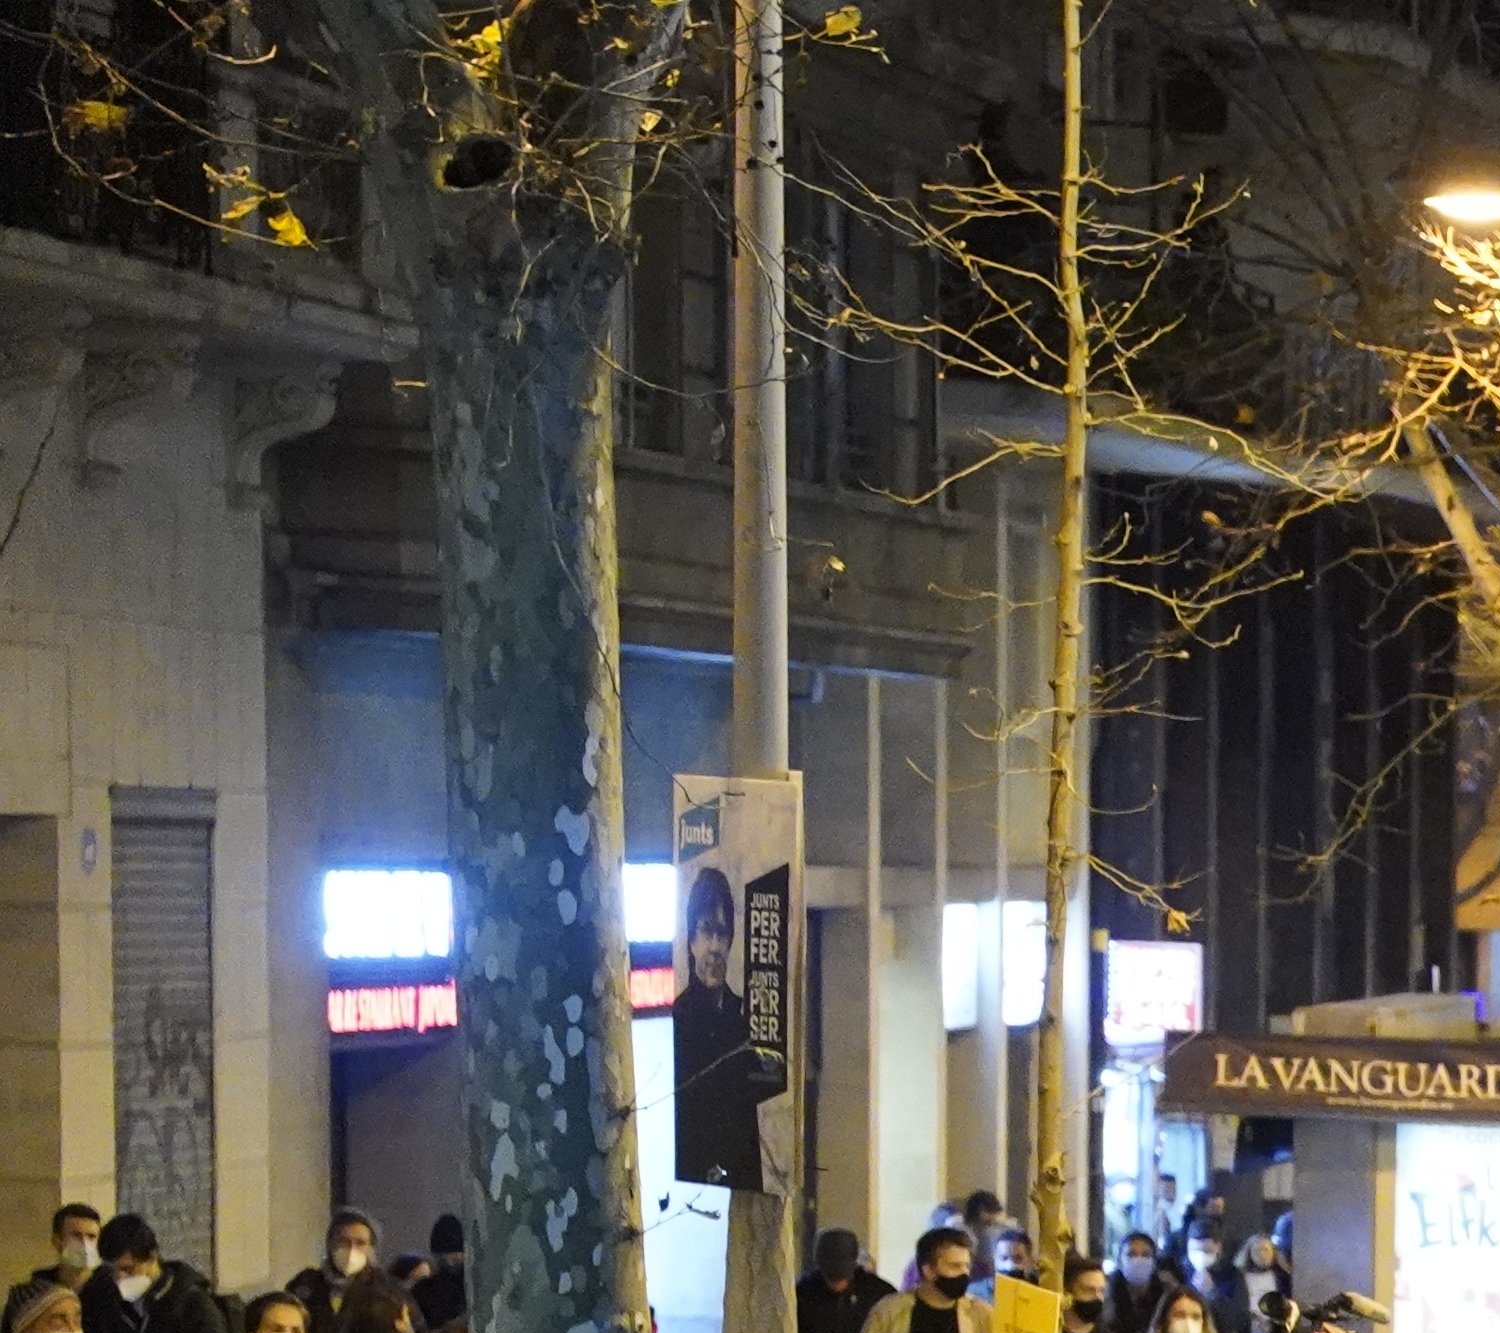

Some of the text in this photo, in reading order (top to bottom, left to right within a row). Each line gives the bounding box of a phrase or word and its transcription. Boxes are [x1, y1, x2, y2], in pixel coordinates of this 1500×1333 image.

[681, 819, 714, 850] junts
[749, 892, 780, 910] JUNTS
[750, 910, 780, 937] PER
[748, 970, 779, 988] JUNTS
[1215, 1053, 1269, 1089] LA
